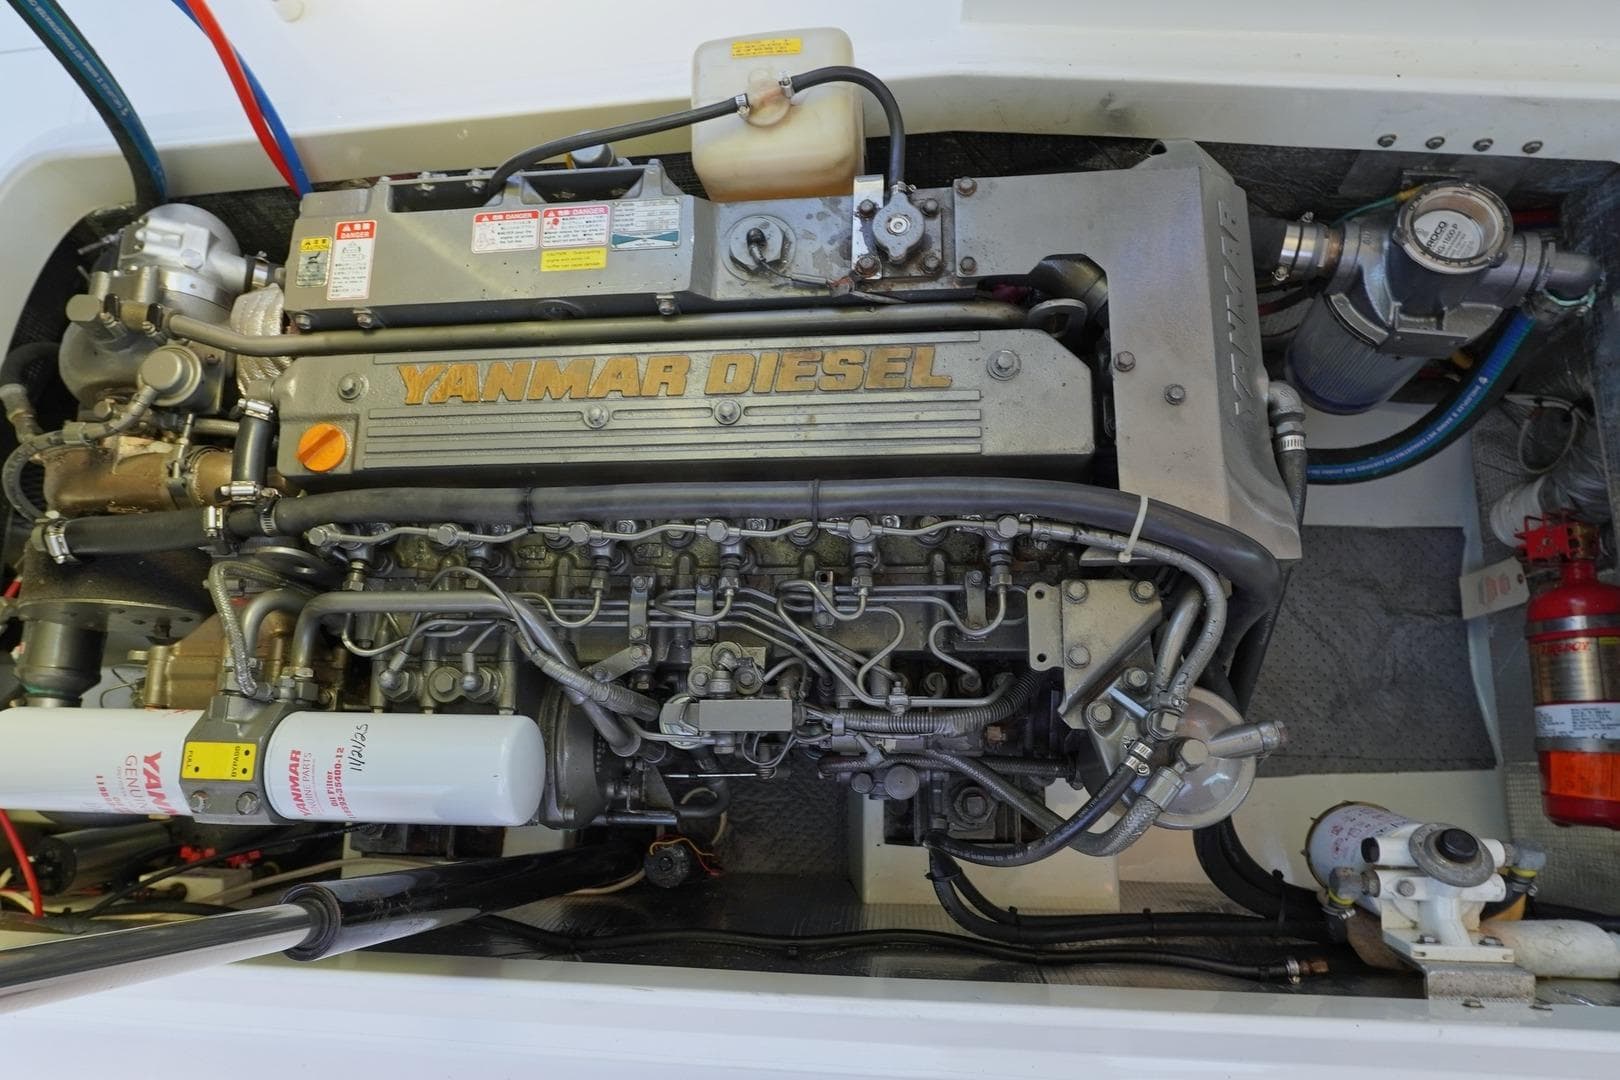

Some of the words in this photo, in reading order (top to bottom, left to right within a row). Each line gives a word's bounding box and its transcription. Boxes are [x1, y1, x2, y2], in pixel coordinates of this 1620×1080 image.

[505, 212, 533, 220] DANGER
[572, 207, 606, 215] DANGER
[1426, 220, 1448, 248] ROCO
[398, 354, 691, 405] YANMAR
[704, 345, 953, 395] DIESEL
[288, 749, 311, 817] YANMAR
